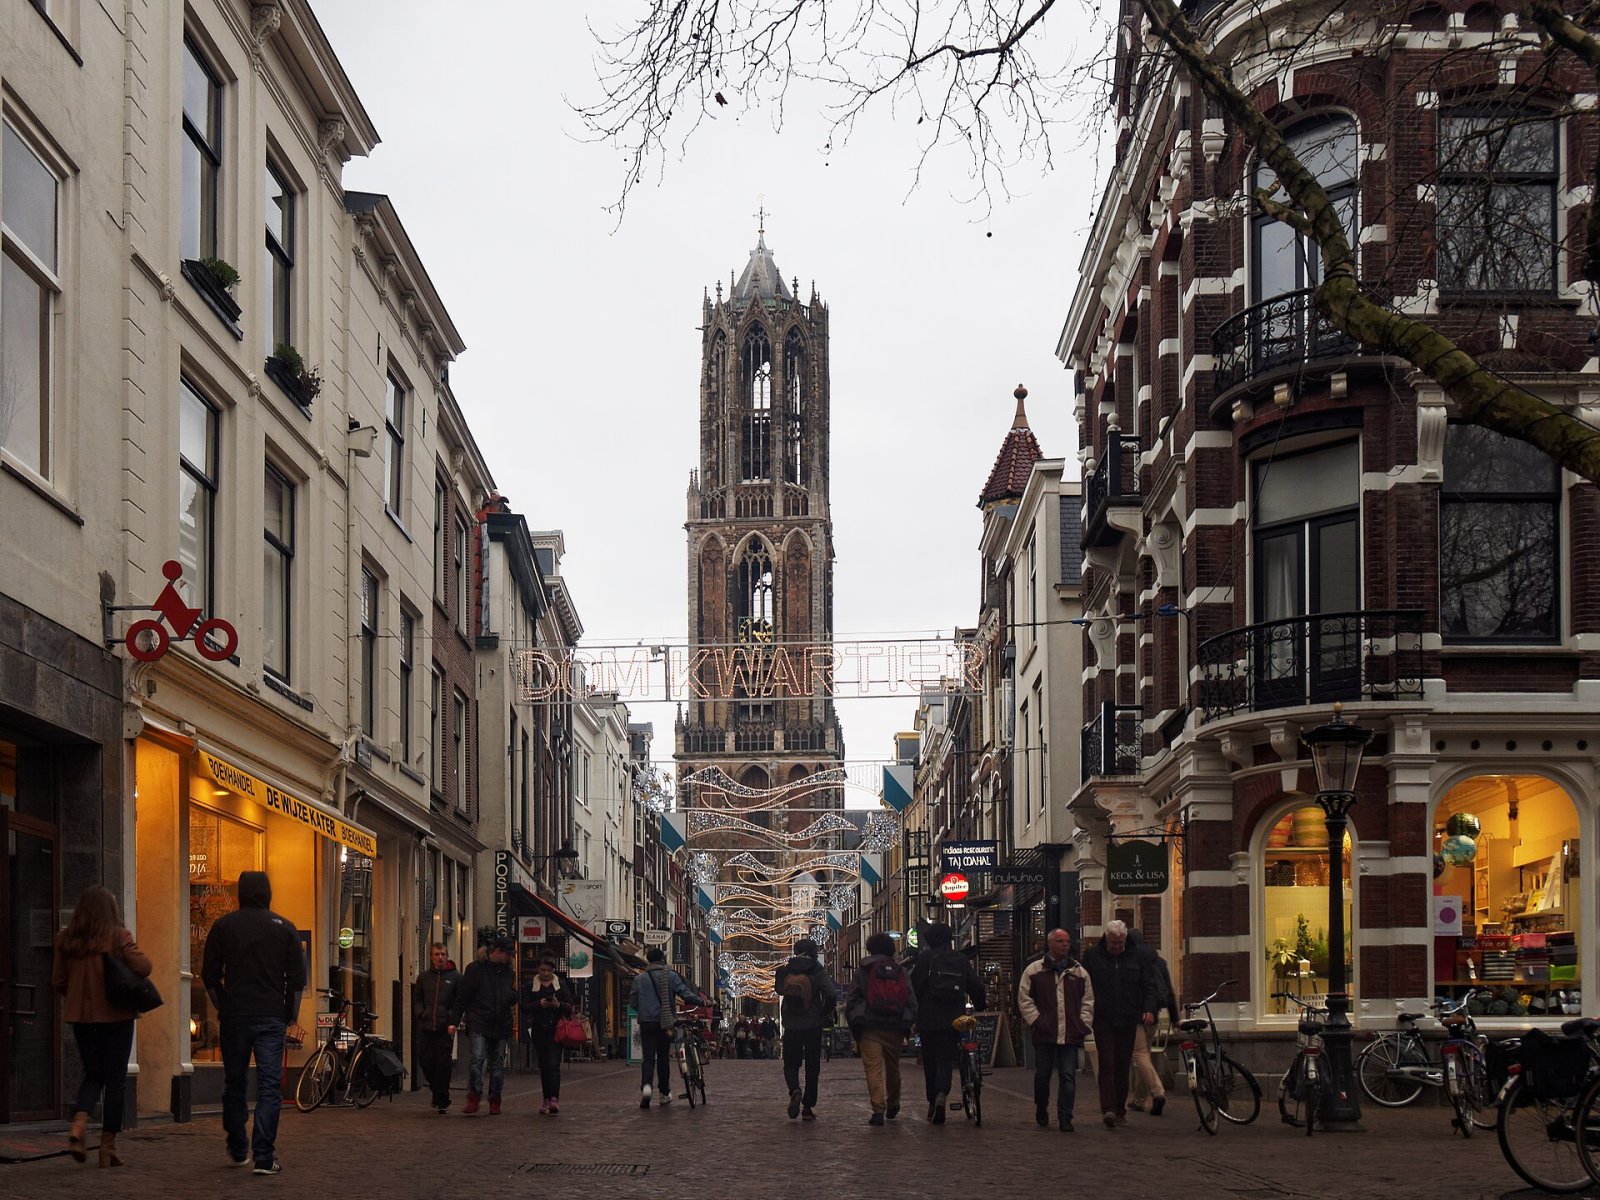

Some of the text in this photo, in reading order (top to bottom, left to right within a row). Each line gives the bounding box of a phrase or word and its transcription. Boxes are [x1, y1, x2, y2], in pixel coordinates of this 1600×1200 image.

[266, 787, 279, 808] DE
[280, 795, 309, 823] WIJZE
[309, 810, 336, 837] KATER
[341, 825, 374, 853] BOEKHANDEL
[948, 857, 961, 869] TAJ
[1110, 869, 1165, 880] KECK & LISA
